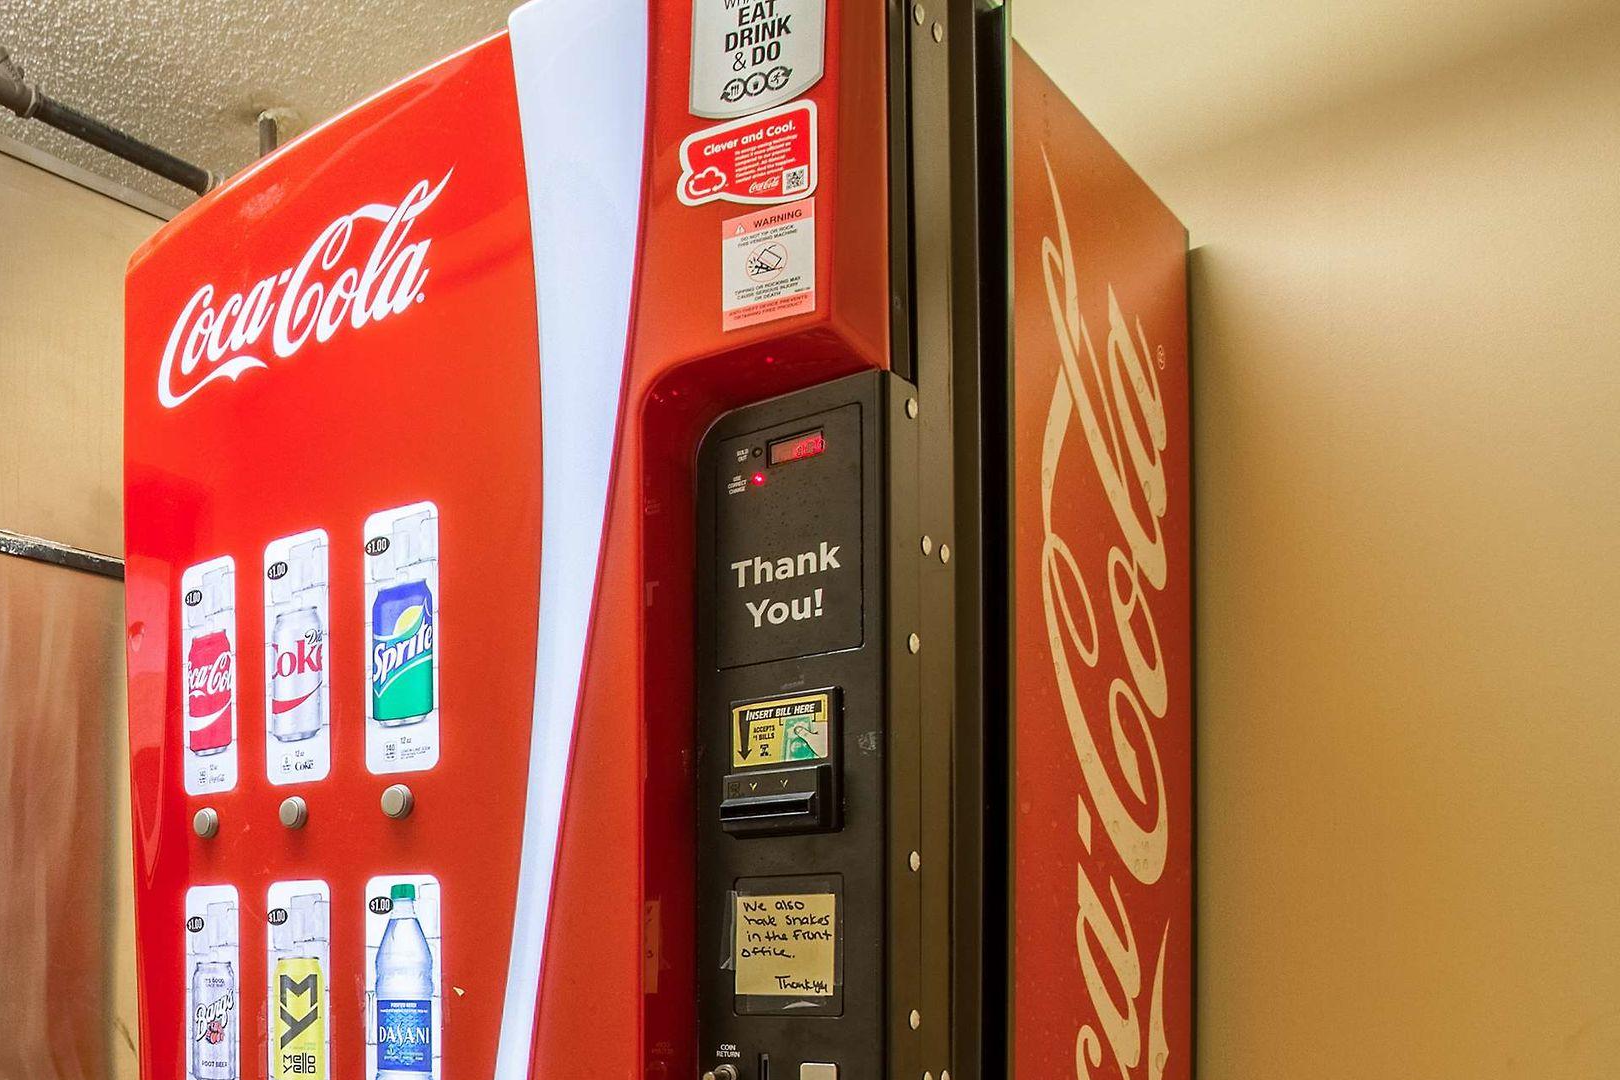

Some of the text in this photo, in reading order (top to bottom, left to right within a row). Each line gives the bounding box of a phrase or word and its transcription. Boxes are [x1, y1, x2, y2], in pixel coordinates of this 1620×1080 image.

[725, 14, 791, 53] DRINK
[732, 41, 781, 71] & DO
[703, 120, 796, 156] Clever and Cool.
[753, 209, 802, 228] WARNING
[158, 162, 455, 409] Coca-Cola
[367, 539, 388, 555] $1.00
[268, 563, 286, 579] $1.00
[731, 541, 841, 588] Thank
[745, 588, 823, 629] You!
[305, 628, 323, 645] Di
[372, 616, 433, 688] Sprite
[746, 703, 816, 721] INSERT BILL HERE
[753, 725, 775, 733] ACCEPTS
[759, 733, 775, 741] BILLS
[370, 899, 390, 911] $1.00
[743, 900, 805, 912] We also
[188, 918, 203, 932] $1.00
[268, 910, 287, 924] $1.00
[743, 915, 777, 926] have
[747, 931, 761, 942] in
[765, 931, 788, 941] the
[379, 1024, 430, 1046] DASANI
[283, 1053, 316, 1064] Mello
[716, 1050, 741, 1058] RETURN
